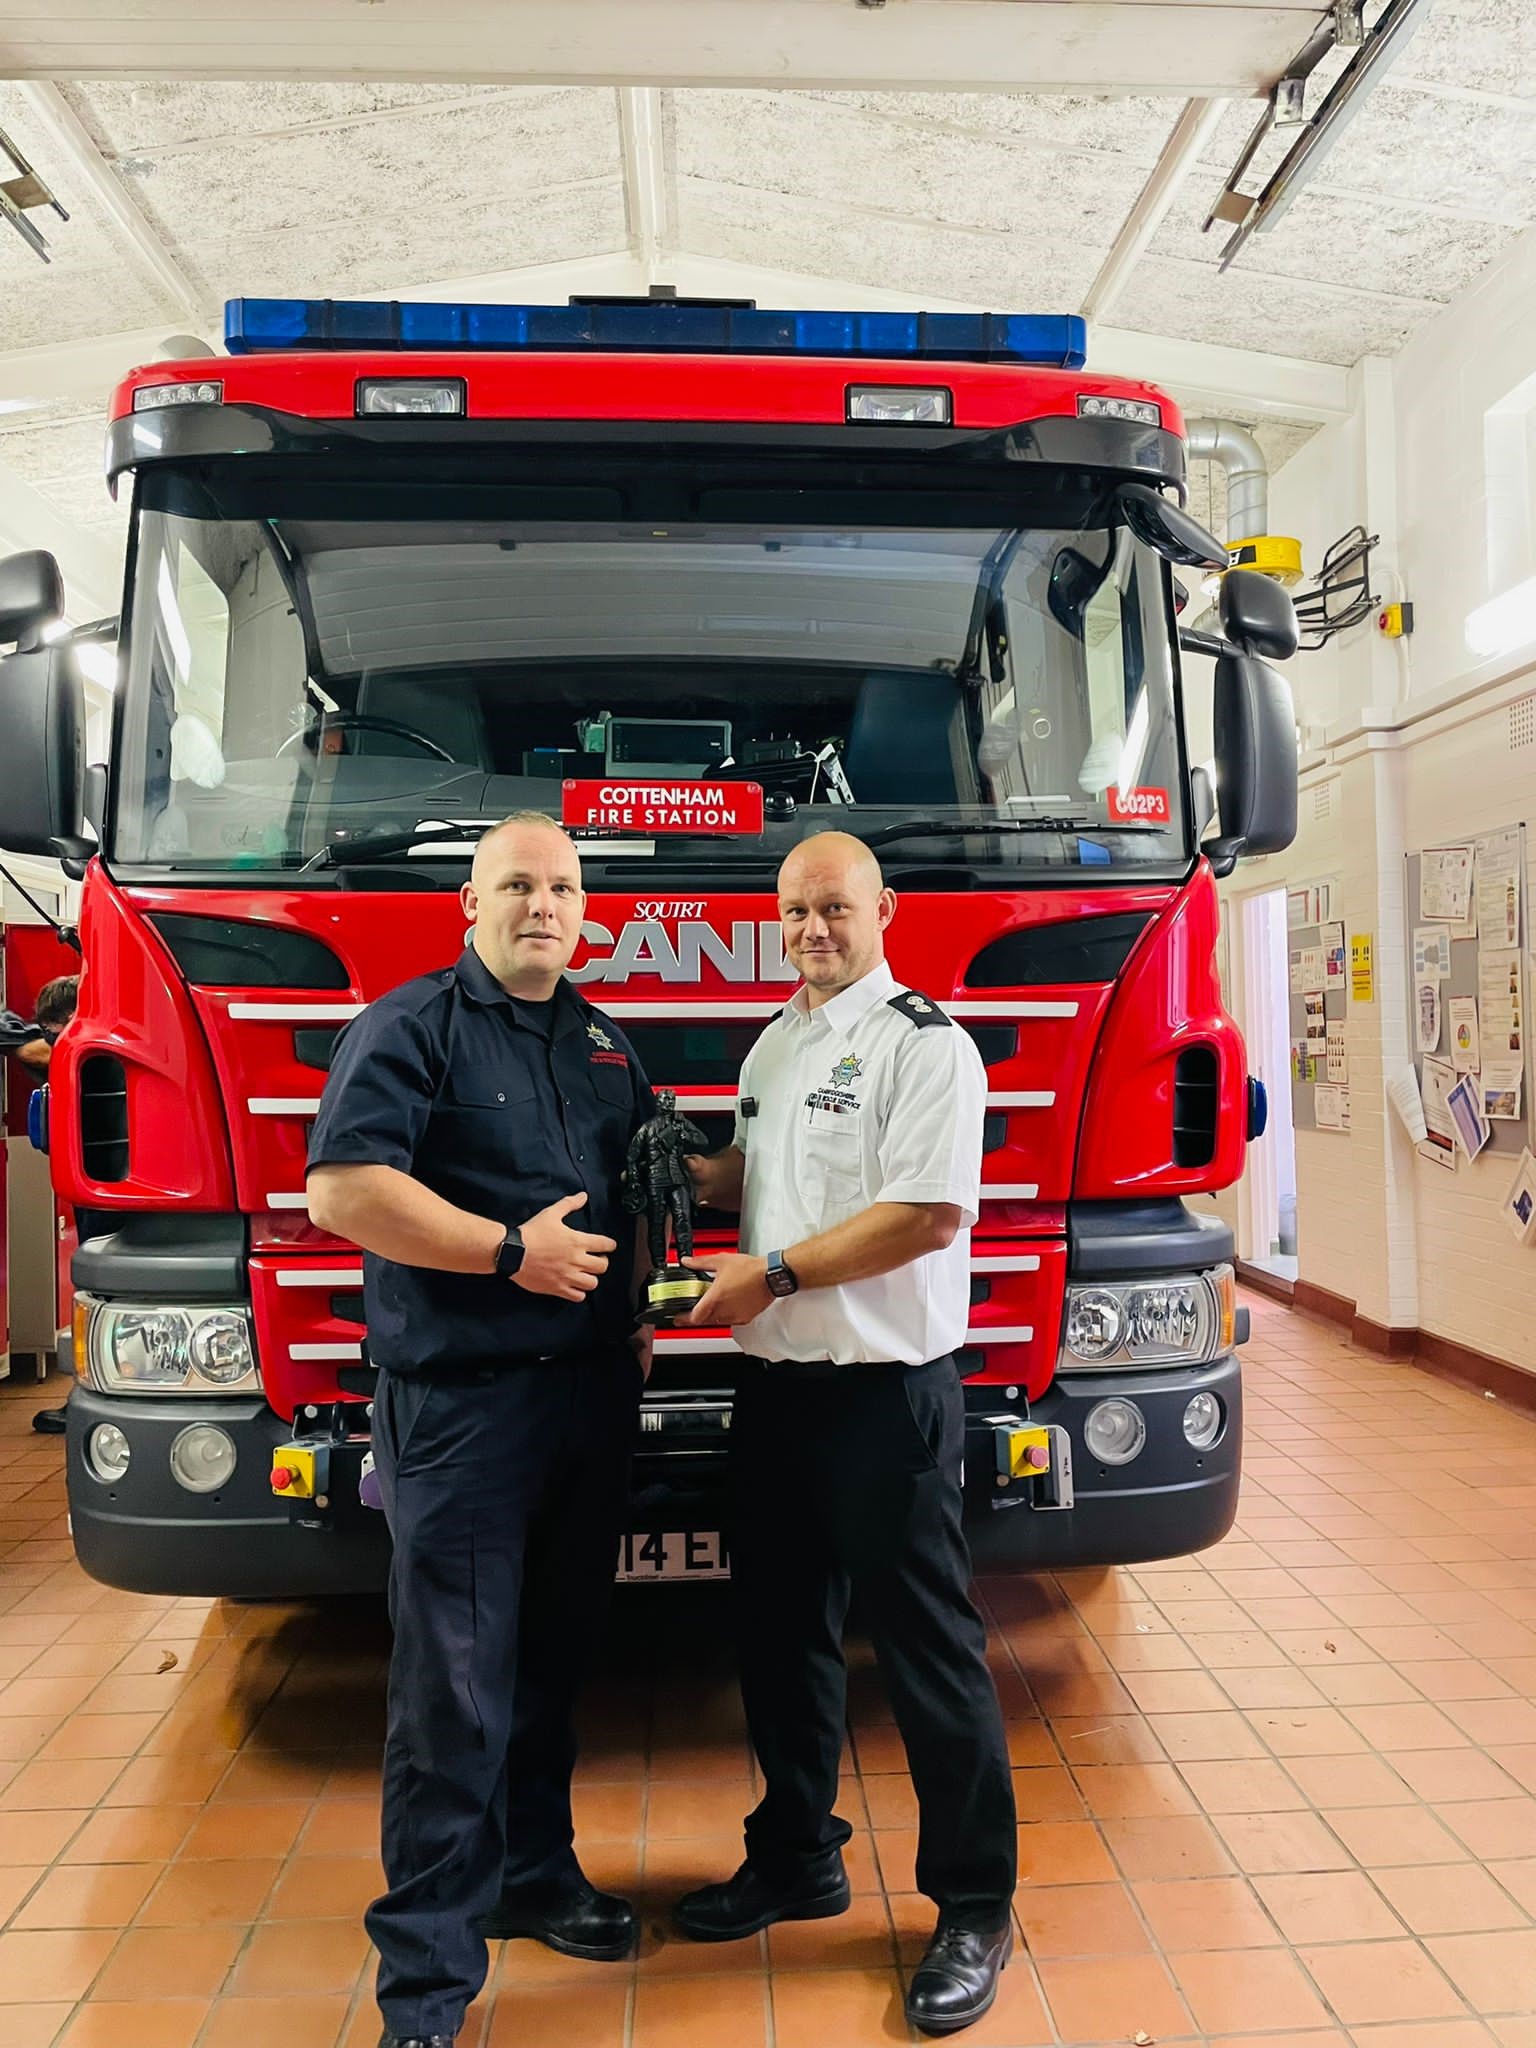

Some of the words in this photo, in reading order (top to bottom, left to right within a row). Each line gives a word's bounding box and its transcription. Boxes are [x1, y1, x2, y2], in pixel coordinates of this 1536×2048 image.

[600, 787, 724, 805] COTTENHAM
[587, 809, 633, 824] FIRE
[645, 809, 735, 825] STATION
[633, 901, 707, 921] SQUIRT
[617, 1531, 668, 1572] 14
